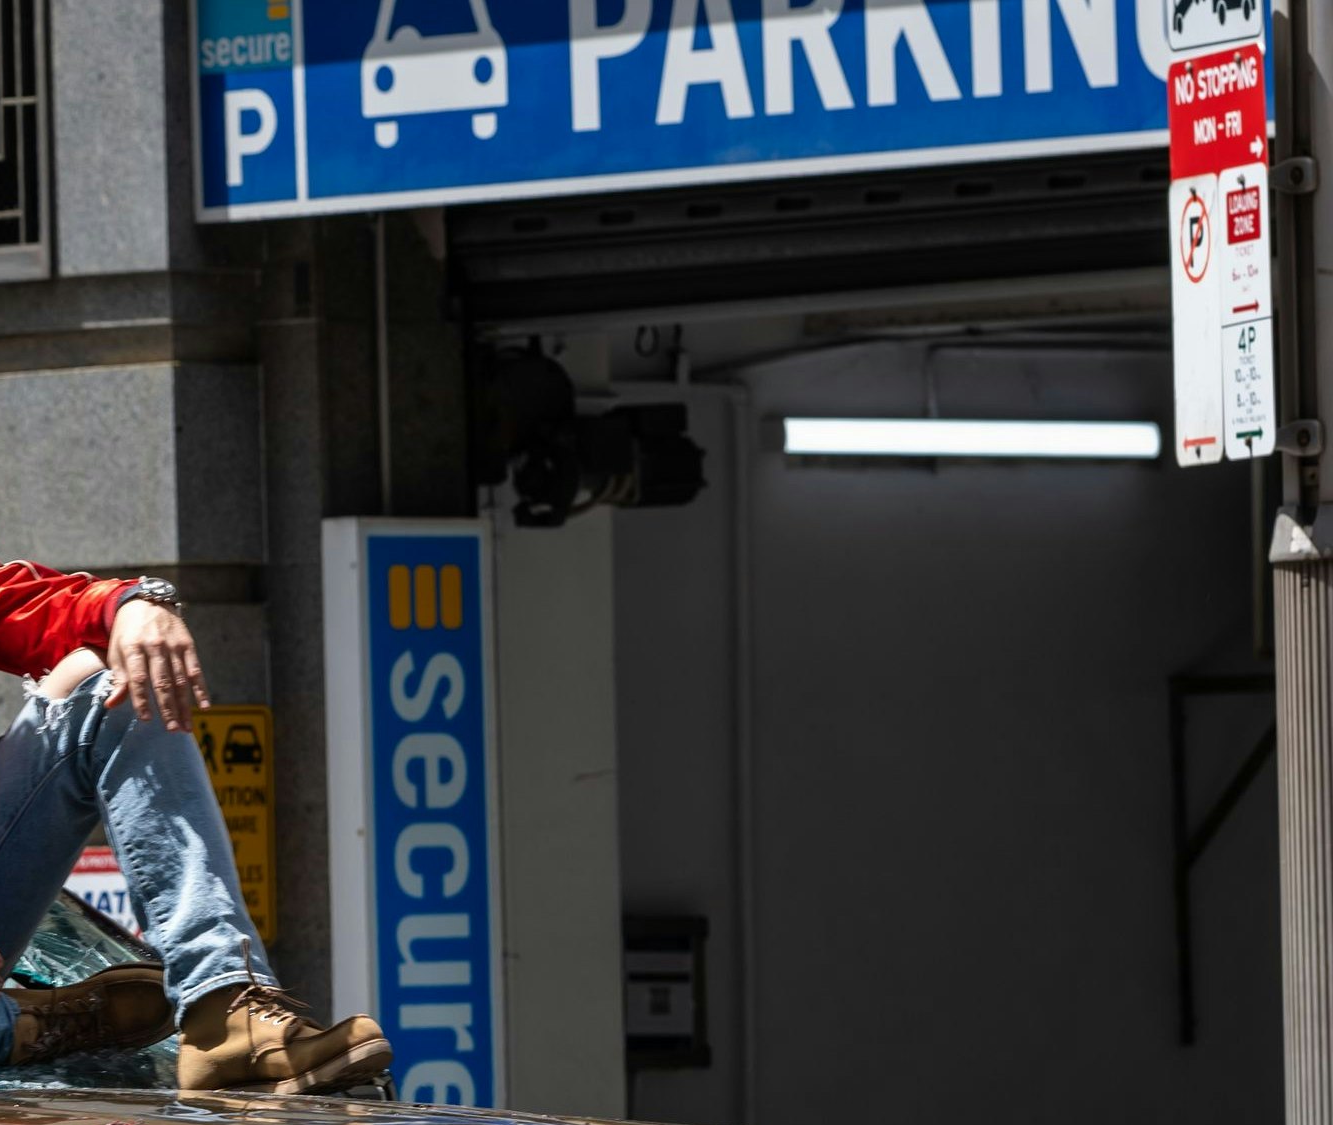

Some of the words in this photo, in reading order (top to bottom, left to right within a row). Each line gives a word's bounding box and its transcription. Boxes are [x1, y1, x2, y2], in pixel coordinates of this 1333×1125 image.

[201, 30, 291, 67] secure
[568, 0, 1170, 132] PARKIN
[1174, 74, 1195, 106] NO
[1197, 56, 1258, 100] STOPPING
[223, 87, 278, 188] P
[1233, 213, 1255, 237] ZONE
[1237, 326, 1256, 353] 4P
[389, 650, 476, 1106] secure
